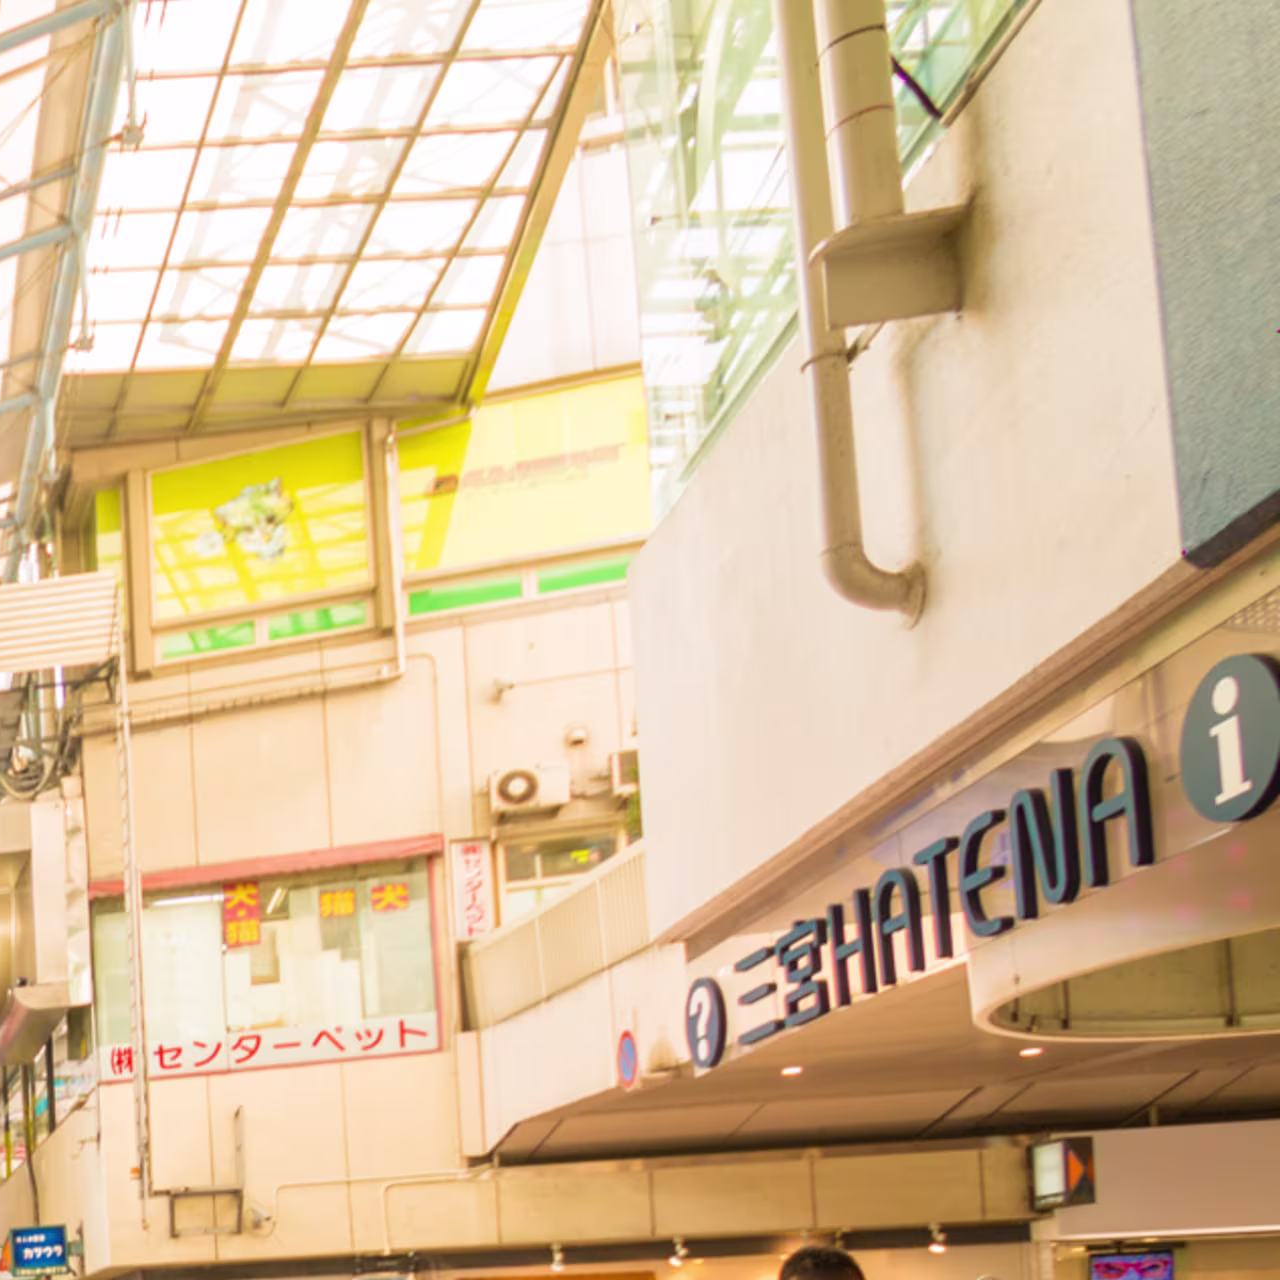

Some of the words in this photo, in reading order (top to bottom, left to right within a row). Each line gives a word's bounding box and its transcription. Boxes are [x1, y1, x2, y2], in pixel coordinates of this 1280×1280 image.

[319, 892, 356, 918] 猫
[371, 884, 409, 911] 犬
[152, 1019, 429, 1071] センターペット
